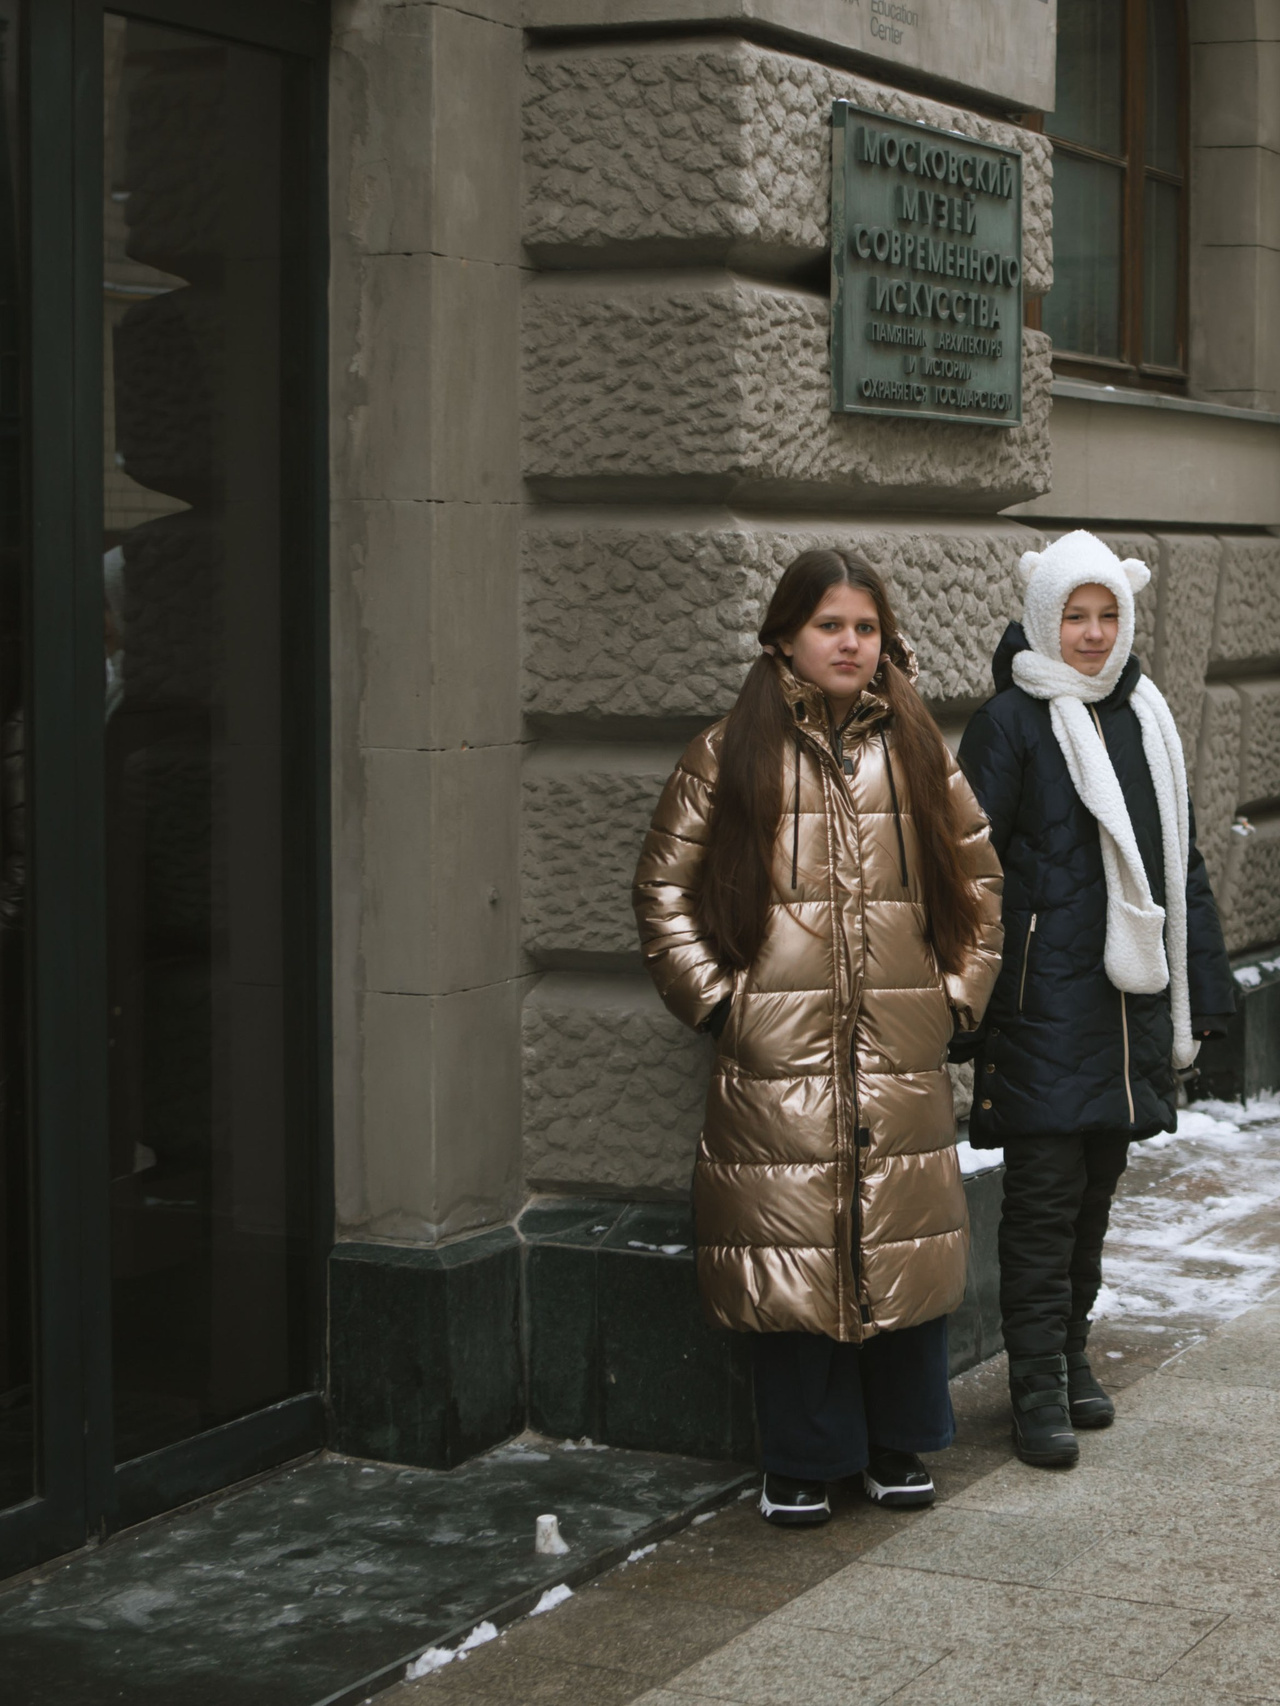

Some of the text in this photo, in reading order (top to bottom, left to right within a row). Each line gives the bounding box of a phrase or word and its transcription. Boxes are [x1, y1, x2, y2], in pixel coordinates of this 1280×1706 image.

[870, 0, 919, 27] Education
[870, 16, 904, 45] Center
[862, 126, 1013, 198] МОСКОВСКИЙ
[901, 185, 977, 235] МУЗЕЙ
[854, 224, 1021, 288] СОВРЕМЕННОГО
[874, 276, 1001, 329] ИСКУССТВА
[870, 321, 1003, 358] ПАМЯТНИК АРХИТЕКТУРЫ
[924, 357, 973, 380] ИСТОРИИ
[861, 378, 1013, 411] ОХРАНЯЕТСЯ ГОСУДАРСТВОМ
